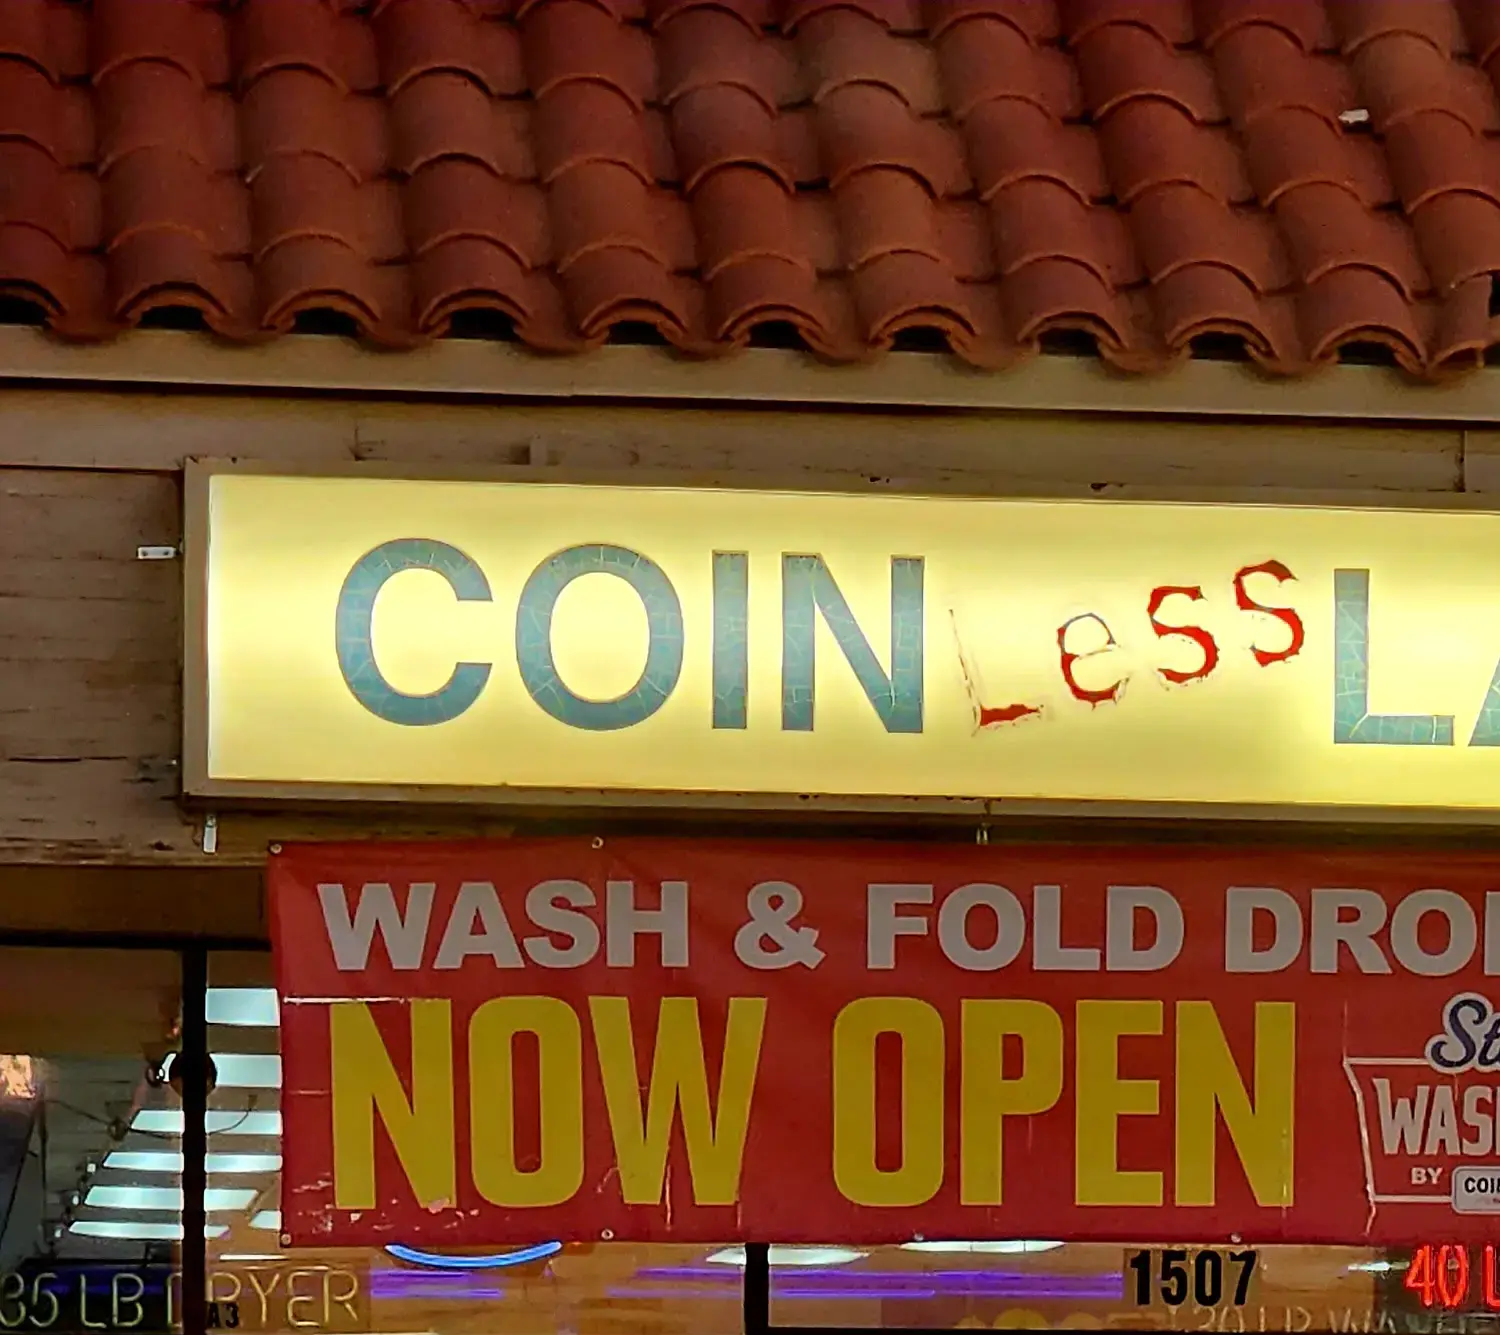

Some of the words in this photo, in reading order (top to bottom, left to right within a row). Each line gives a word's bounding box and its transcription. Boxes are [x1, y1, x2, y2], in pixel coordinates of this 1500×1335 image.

[335, 537, 925, 733] COIN
[317, 880, 689, 971] WASH
[734, 882, 826, 971] &
[867, 884, 1185, 973] FOLD
[328, 996, 768, 1210] NOW
[833, 997, 1296, 1209] OPEN
[1410, 1167, 1443, 1185] BY
[80, 1272, 144, 1328] LB
[1130, 1249, 1257, 1307] 1507
[1404, 1245, 1469, 1308] 40
